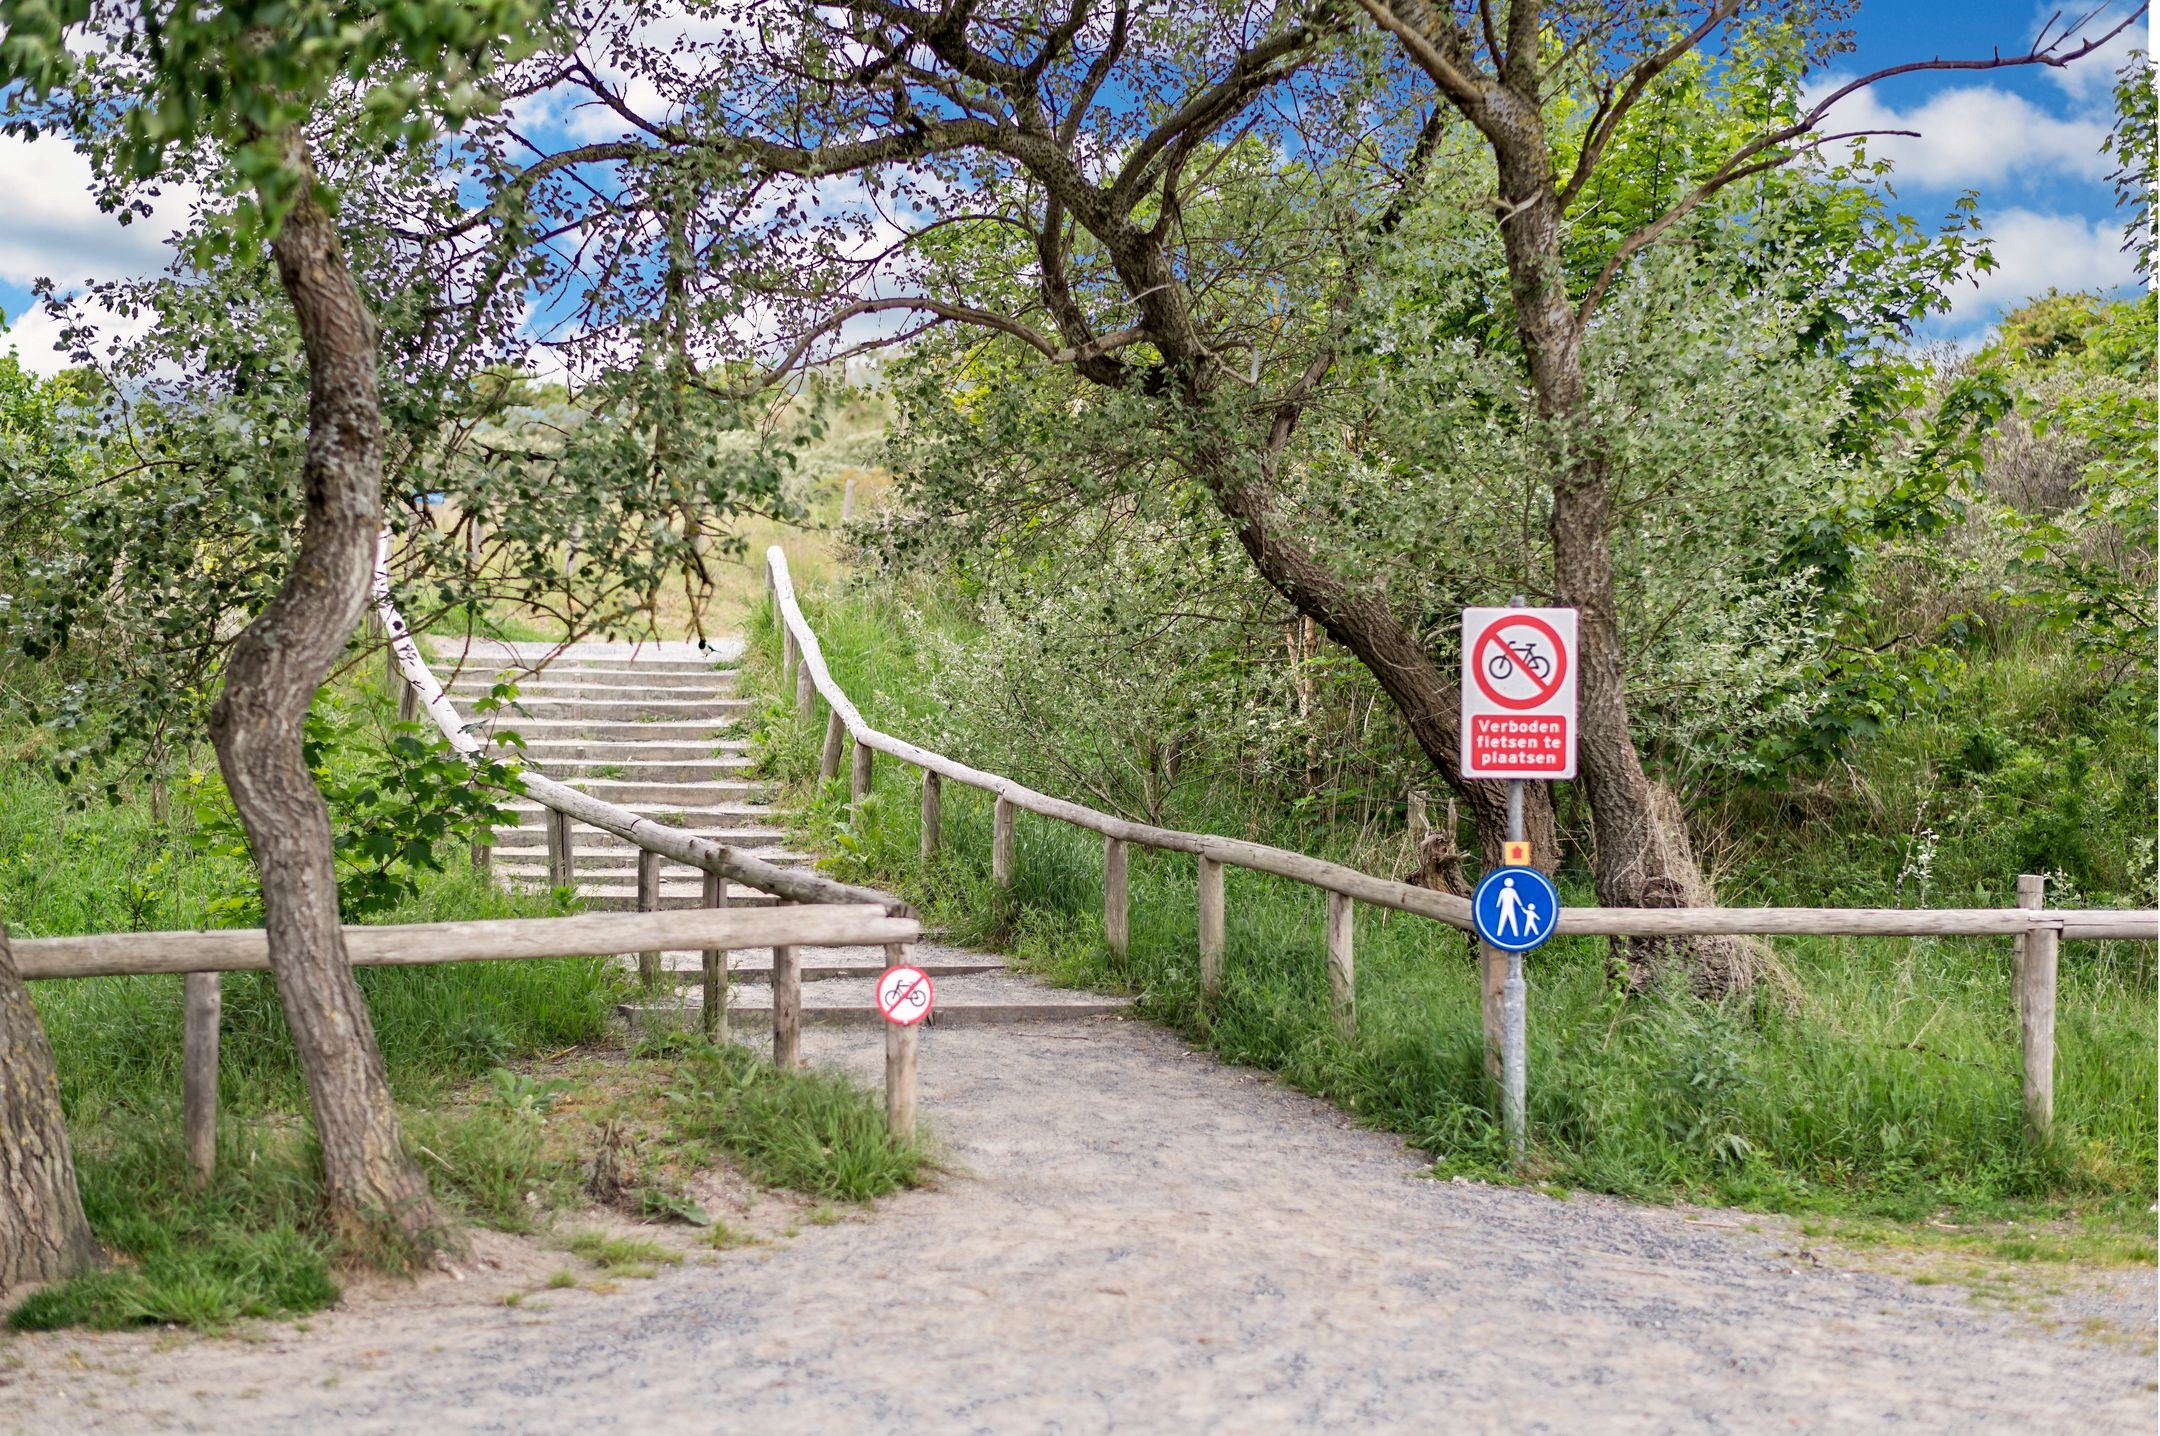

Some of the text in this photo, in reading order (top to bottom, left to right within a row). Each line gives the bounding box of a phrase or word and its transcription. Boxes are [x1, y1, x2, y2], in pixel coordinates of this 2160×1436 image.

[1478, 719, 1560, 733] Verboden
[1476, 735, 1562, 748] fietsen te
[1481, 751, 1557, 766] plaatsen
